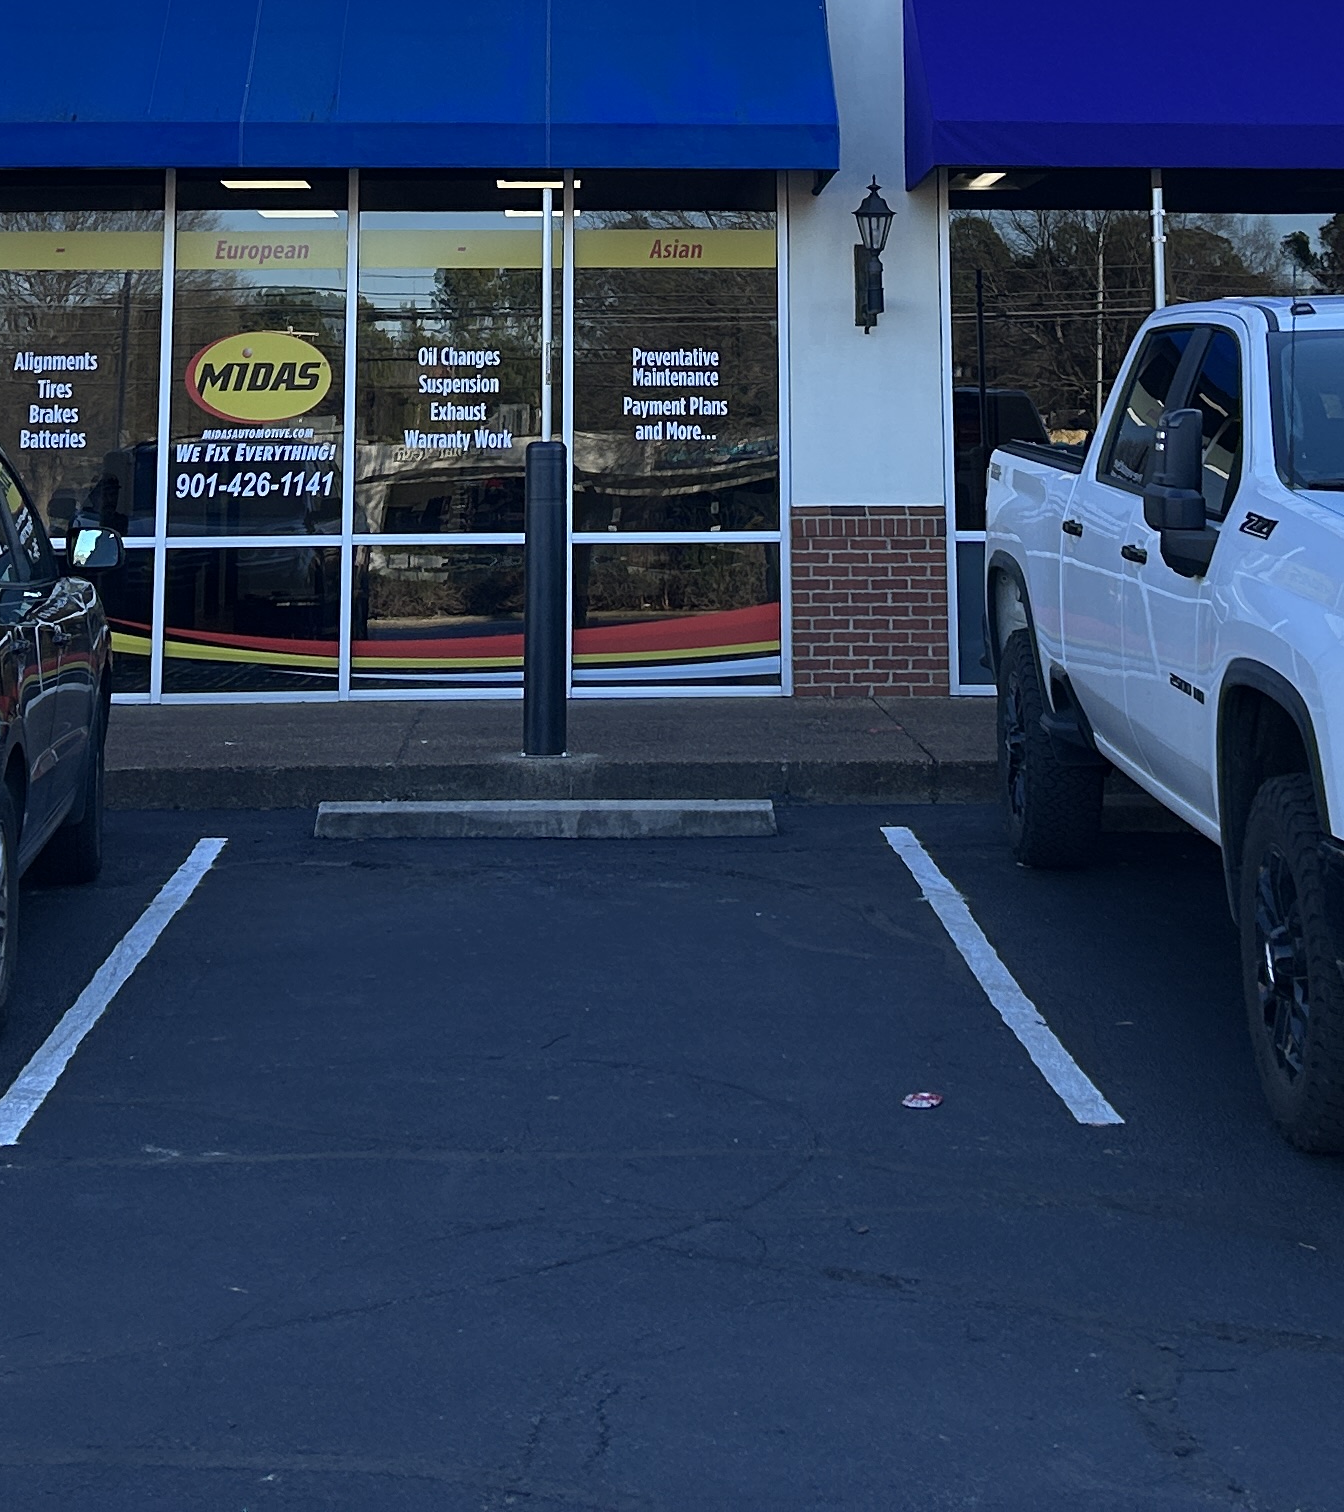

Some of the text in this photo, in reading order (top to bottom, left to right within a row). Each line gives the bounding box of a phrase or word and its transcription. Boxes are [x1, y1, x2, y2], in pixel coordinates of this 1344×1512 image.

[215, 240, 310, 264] European
[649, 239, 703, 259] Asian
[14, 351, 98, 374] Alignments
[418, 346, 501, 369] Oil Changes
[632, 347, 719, 367] Preventative
[197, 360, 322, 398] MIDAS
[418, 374, 499, 396] Suspension
[632, 368, 719, 387] Maintenance
[37, 379, 73, 399] Tires
[29, 404, 79, 424] Brakes
[430, 402, 487, 421] Exhaust
[623, 396, 728, 418] Payment Plans
[20, 429, 87, 449] Batteries
[404, 429, 513, 451] Warranty Work
[635, 420, 717, 441] and More...
[175, 471, 335, 499] 901-426-1141
